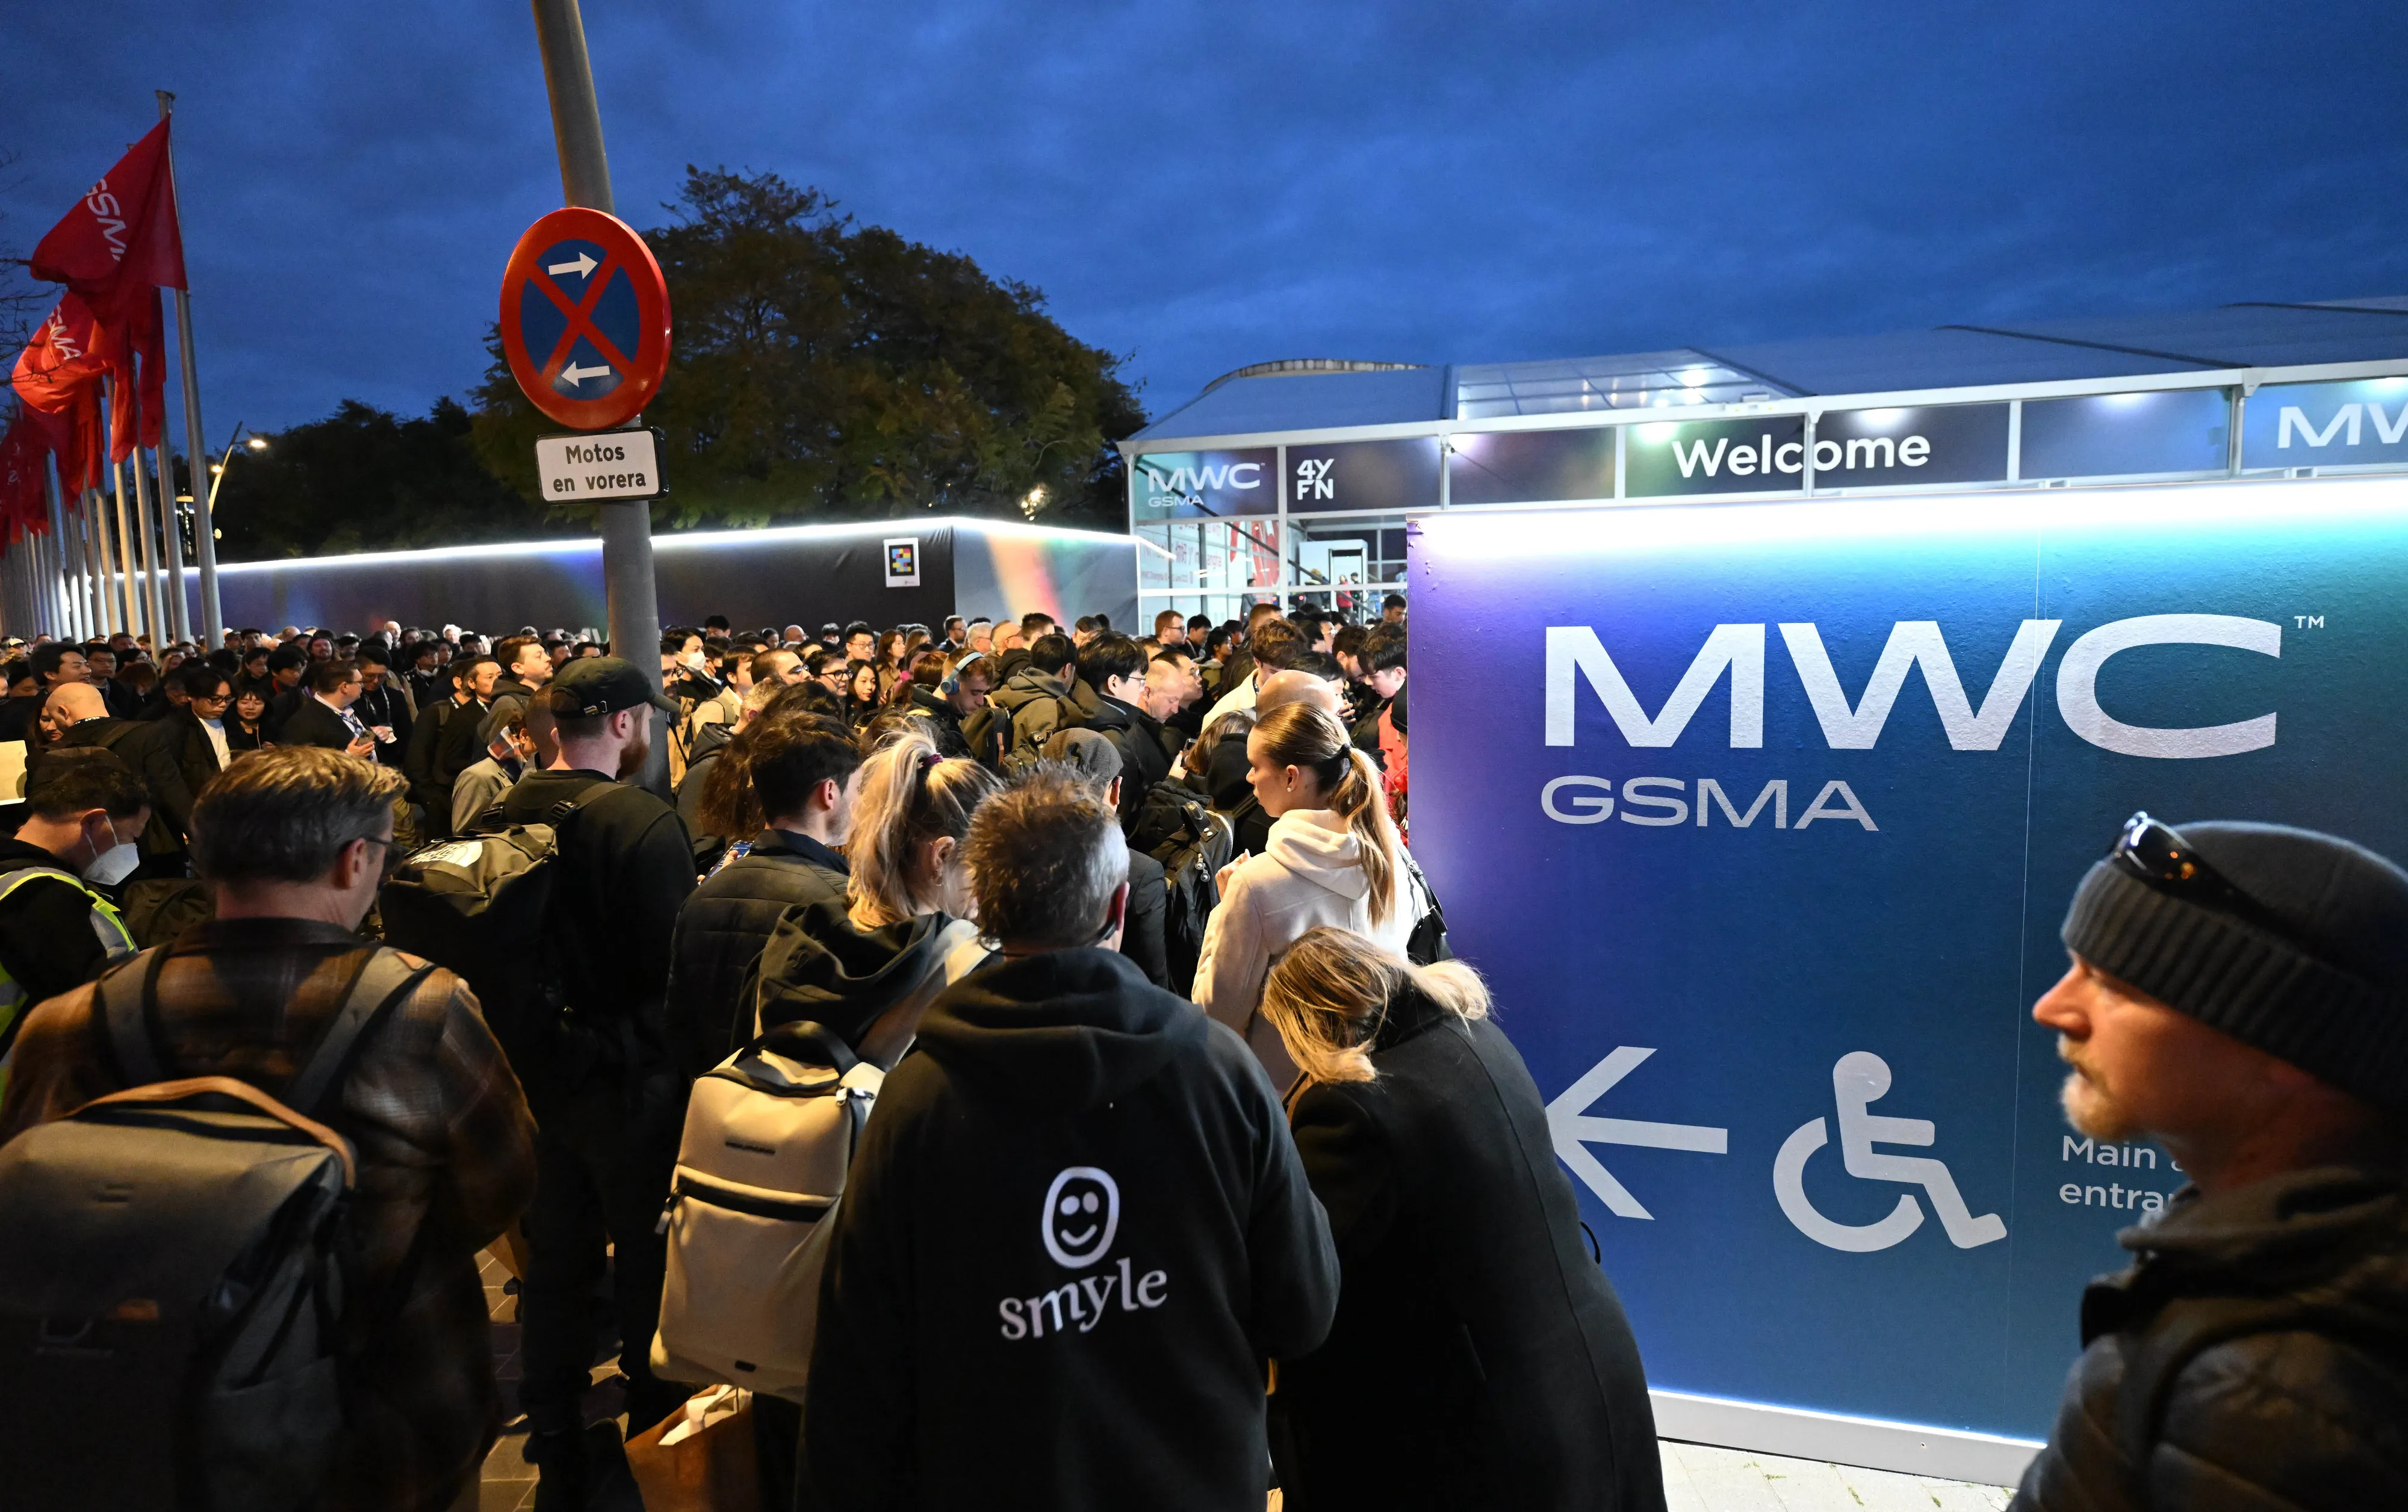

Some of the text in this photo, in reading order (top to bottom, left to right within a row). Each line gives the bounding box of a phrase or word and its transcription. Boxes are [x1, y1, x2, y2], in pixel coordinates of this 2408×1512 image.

[565, 443, 625, 464] Motos
[1671, 433, 1931, 479] Welcome
[553, 472, 647, 493] en vorera
[1148, 462, 1261, 492] MWC
[1297, 458, 1335, 480] 4Y
[1147, 494, 1204, 507] GSMA
[1297, 479, 1334, 500] FN
[1544, 613, 2282, 759] MWC
[1540, 775, 1879, 831] GSMA
[2062, 1135, 2156, 1170] Main
[999, 1256, 1168, 1340] smyle
